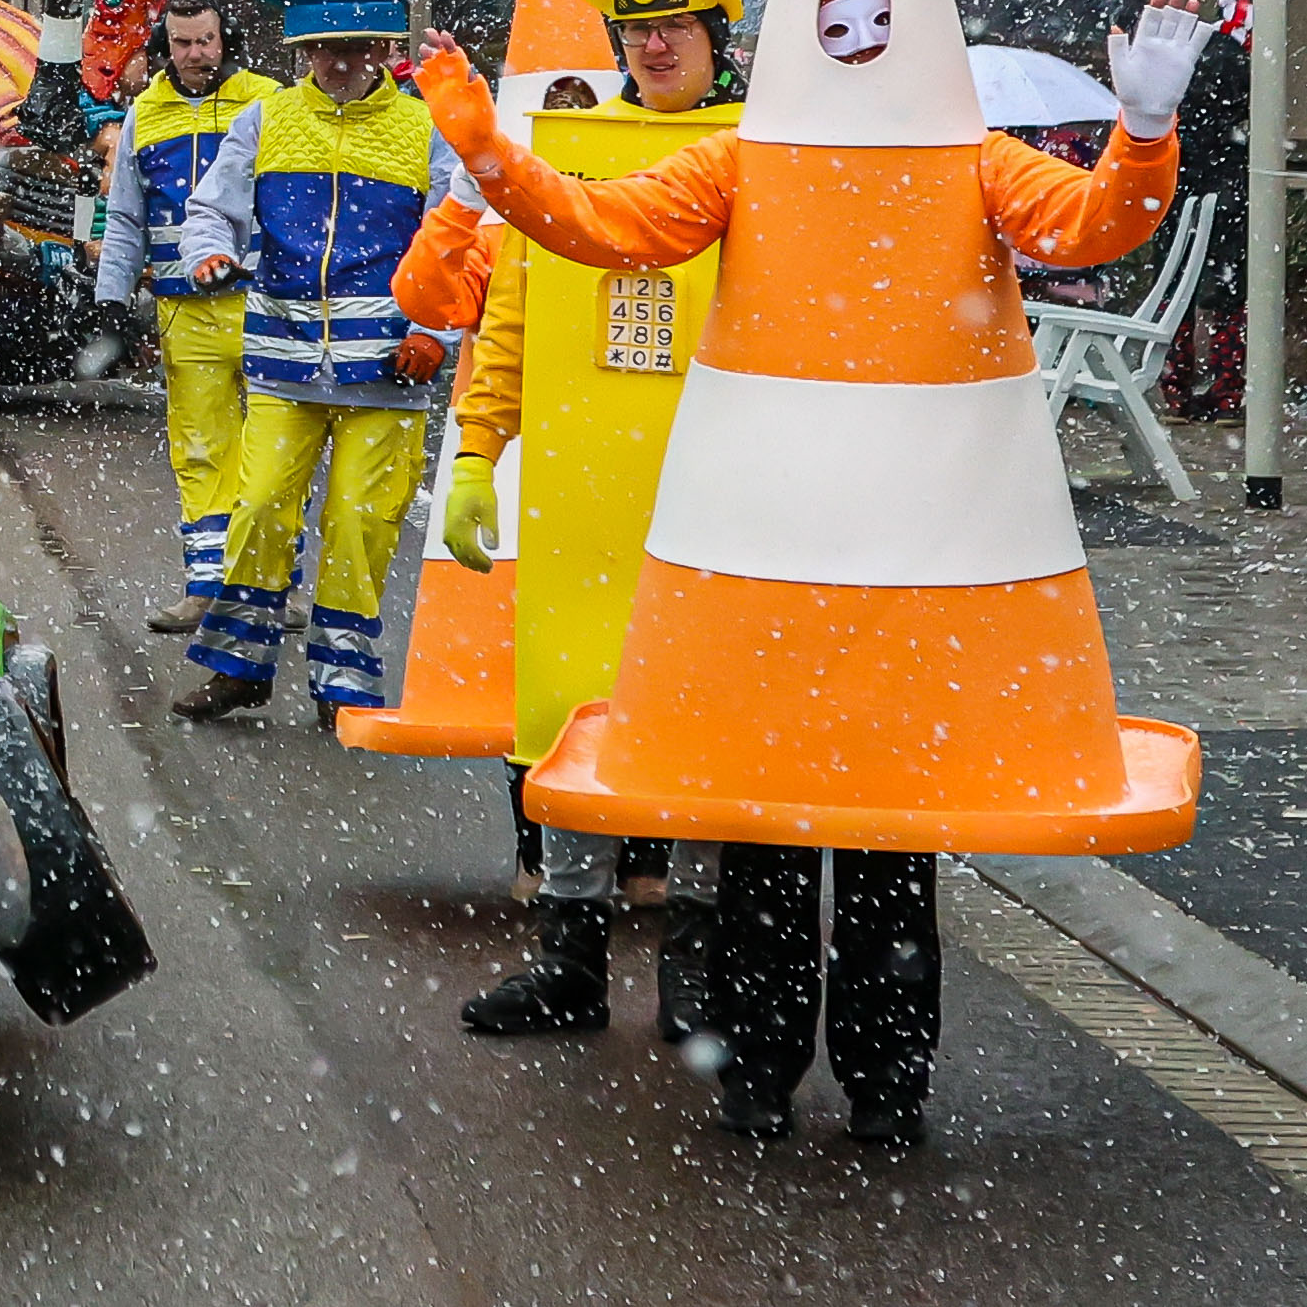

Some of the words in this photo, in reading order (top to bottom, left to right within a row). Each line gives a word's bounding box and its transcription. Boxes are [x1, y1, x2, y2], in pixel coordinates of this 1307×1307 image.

[616, 278, 622, 294] 1
[637, 278, 649, 296] 2
[659, 280, 673, 298] 3
[612, 301, 626, 318] 4
[635, 302, 649, 320] 5
[658, 304, 673, 322] 6
[611, 325, 625, 341] 7
[633, 325, 648, 344] 8
[657, 328, 673, 346] 9
